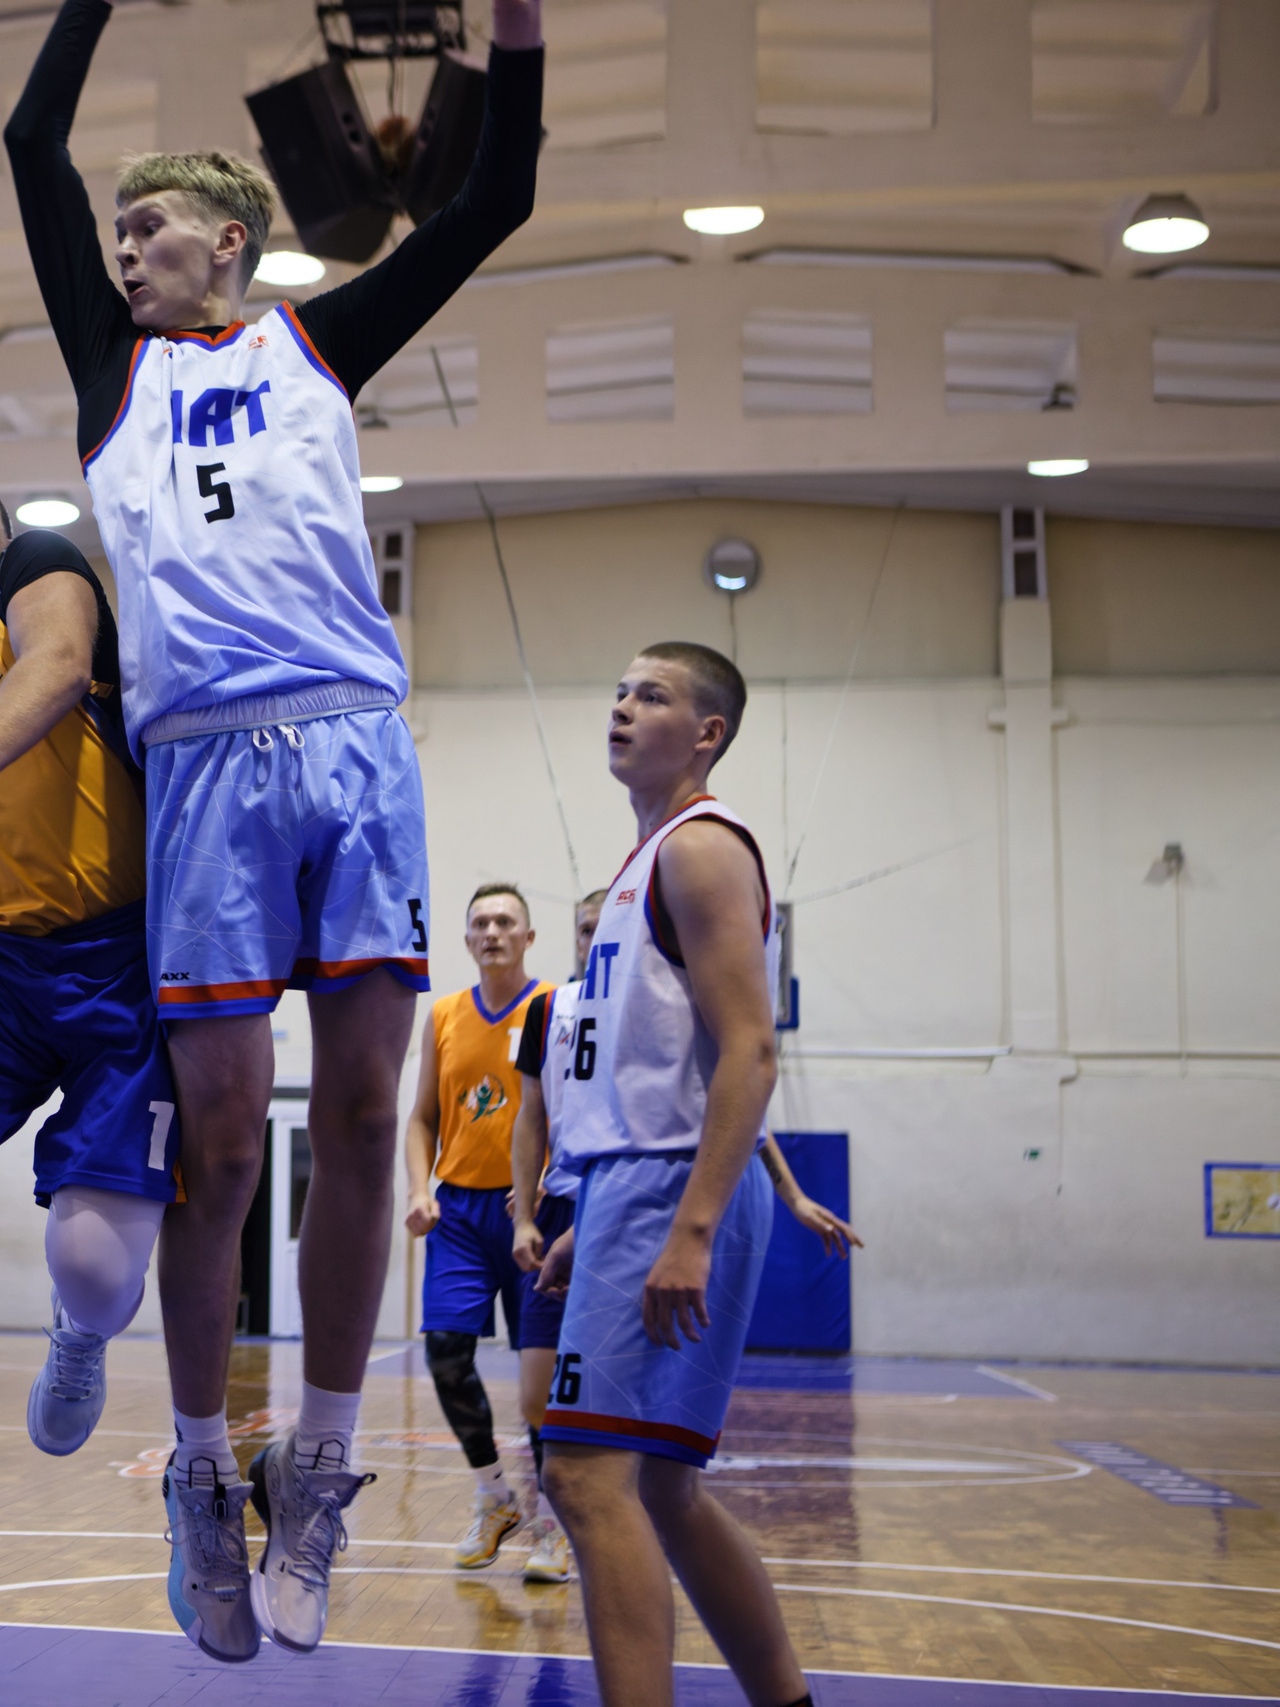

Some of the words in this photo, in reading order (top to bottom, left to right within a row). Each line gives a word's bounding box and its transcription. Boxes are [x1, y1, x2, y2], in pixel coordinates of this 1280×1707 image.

[196, 462, 235, 524] 5
[408, 898, 428, 952] 5
[160, 972, 190, 980] AXX
[564, 1017, 596, 1080] 6
[148, 1101, 175, 1171] 1
